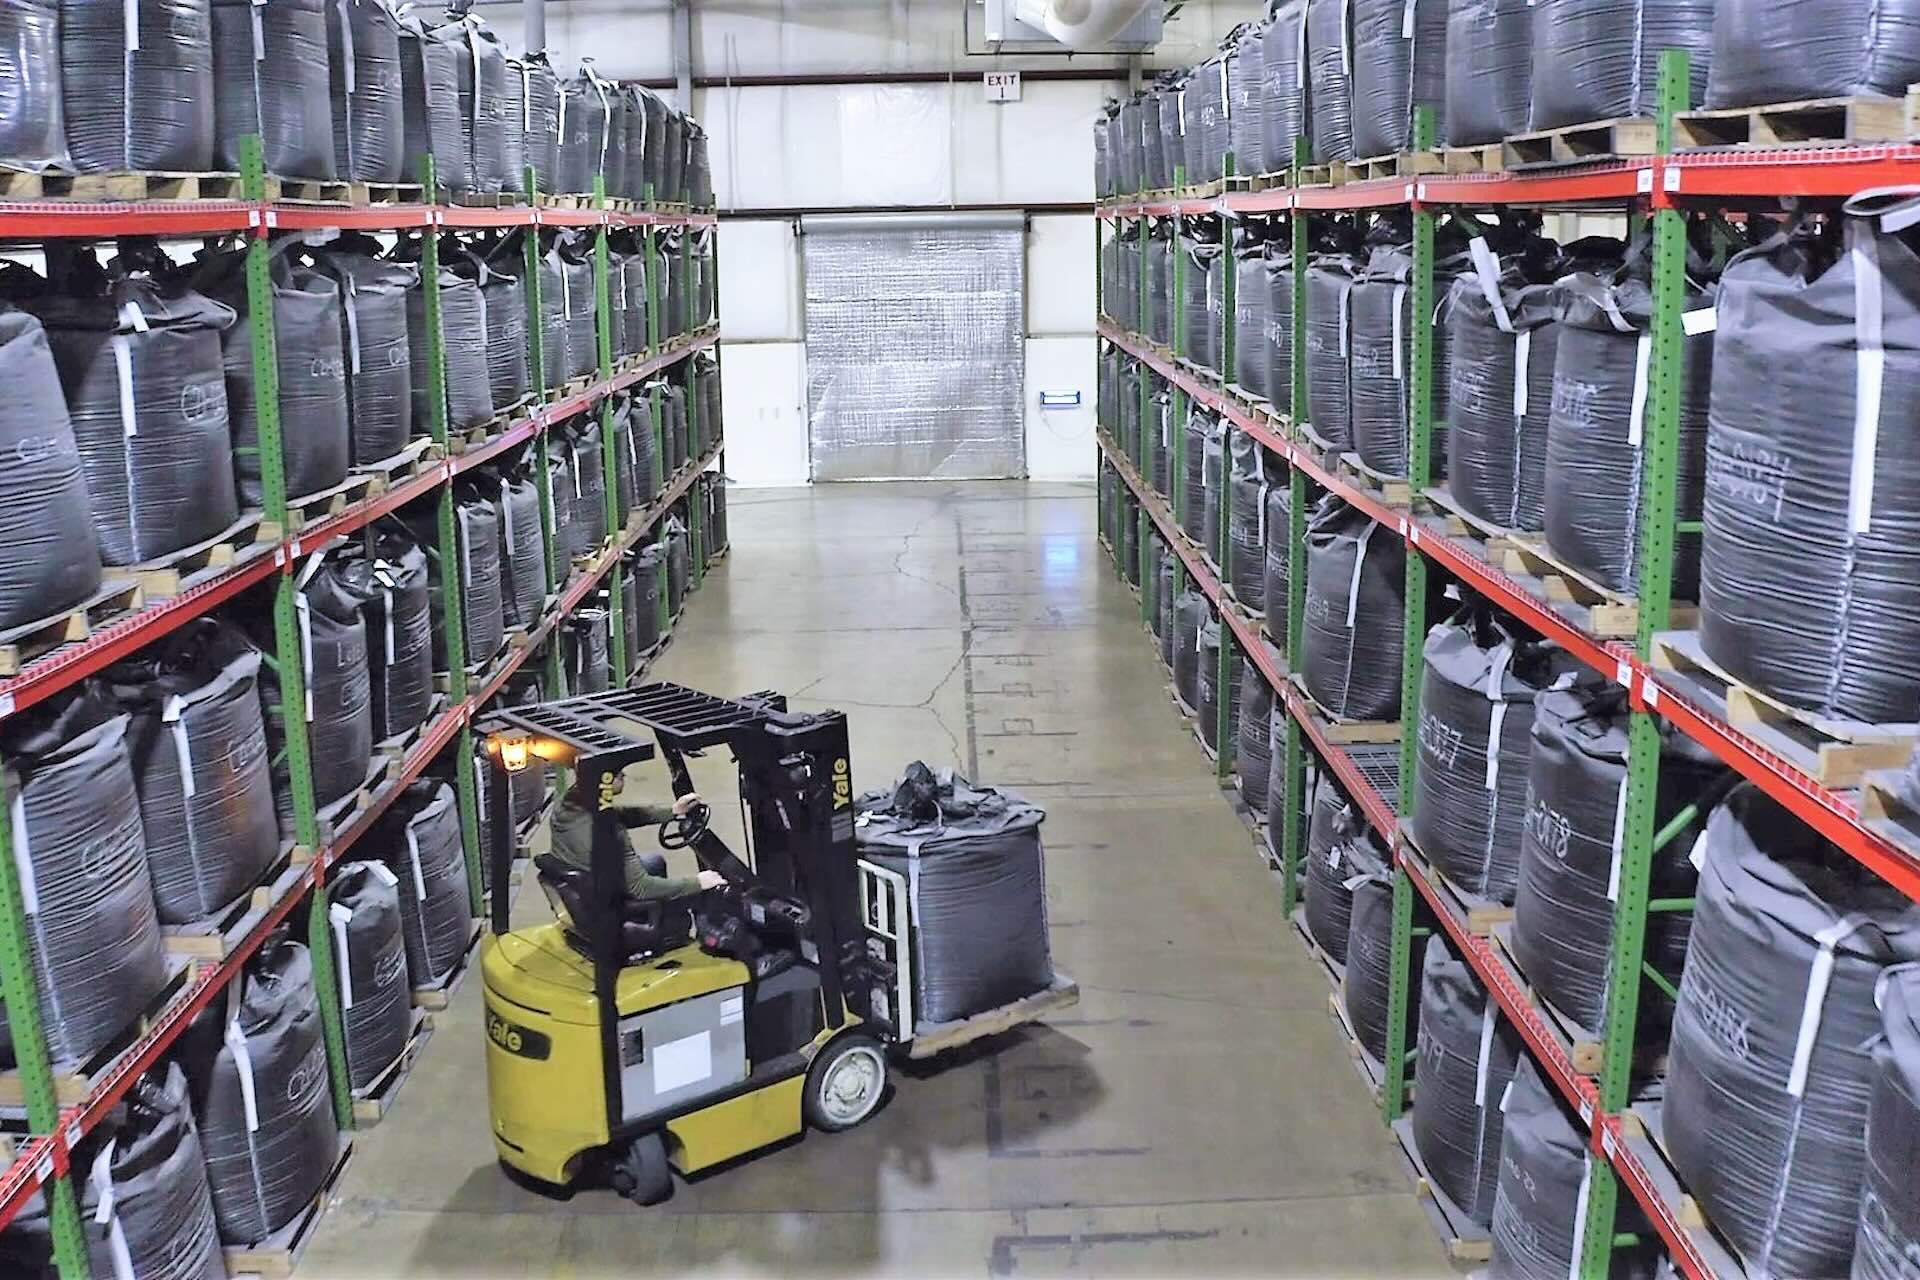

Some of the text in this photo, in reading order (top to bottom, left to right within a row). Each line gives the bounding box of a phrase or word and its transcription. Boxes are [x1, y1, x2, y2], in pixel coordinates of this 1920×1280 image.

[988, 75, 1017, 86] EXIT
[598, 771, 615, 812] Yale
[832, 757, 849, 810] Yale
